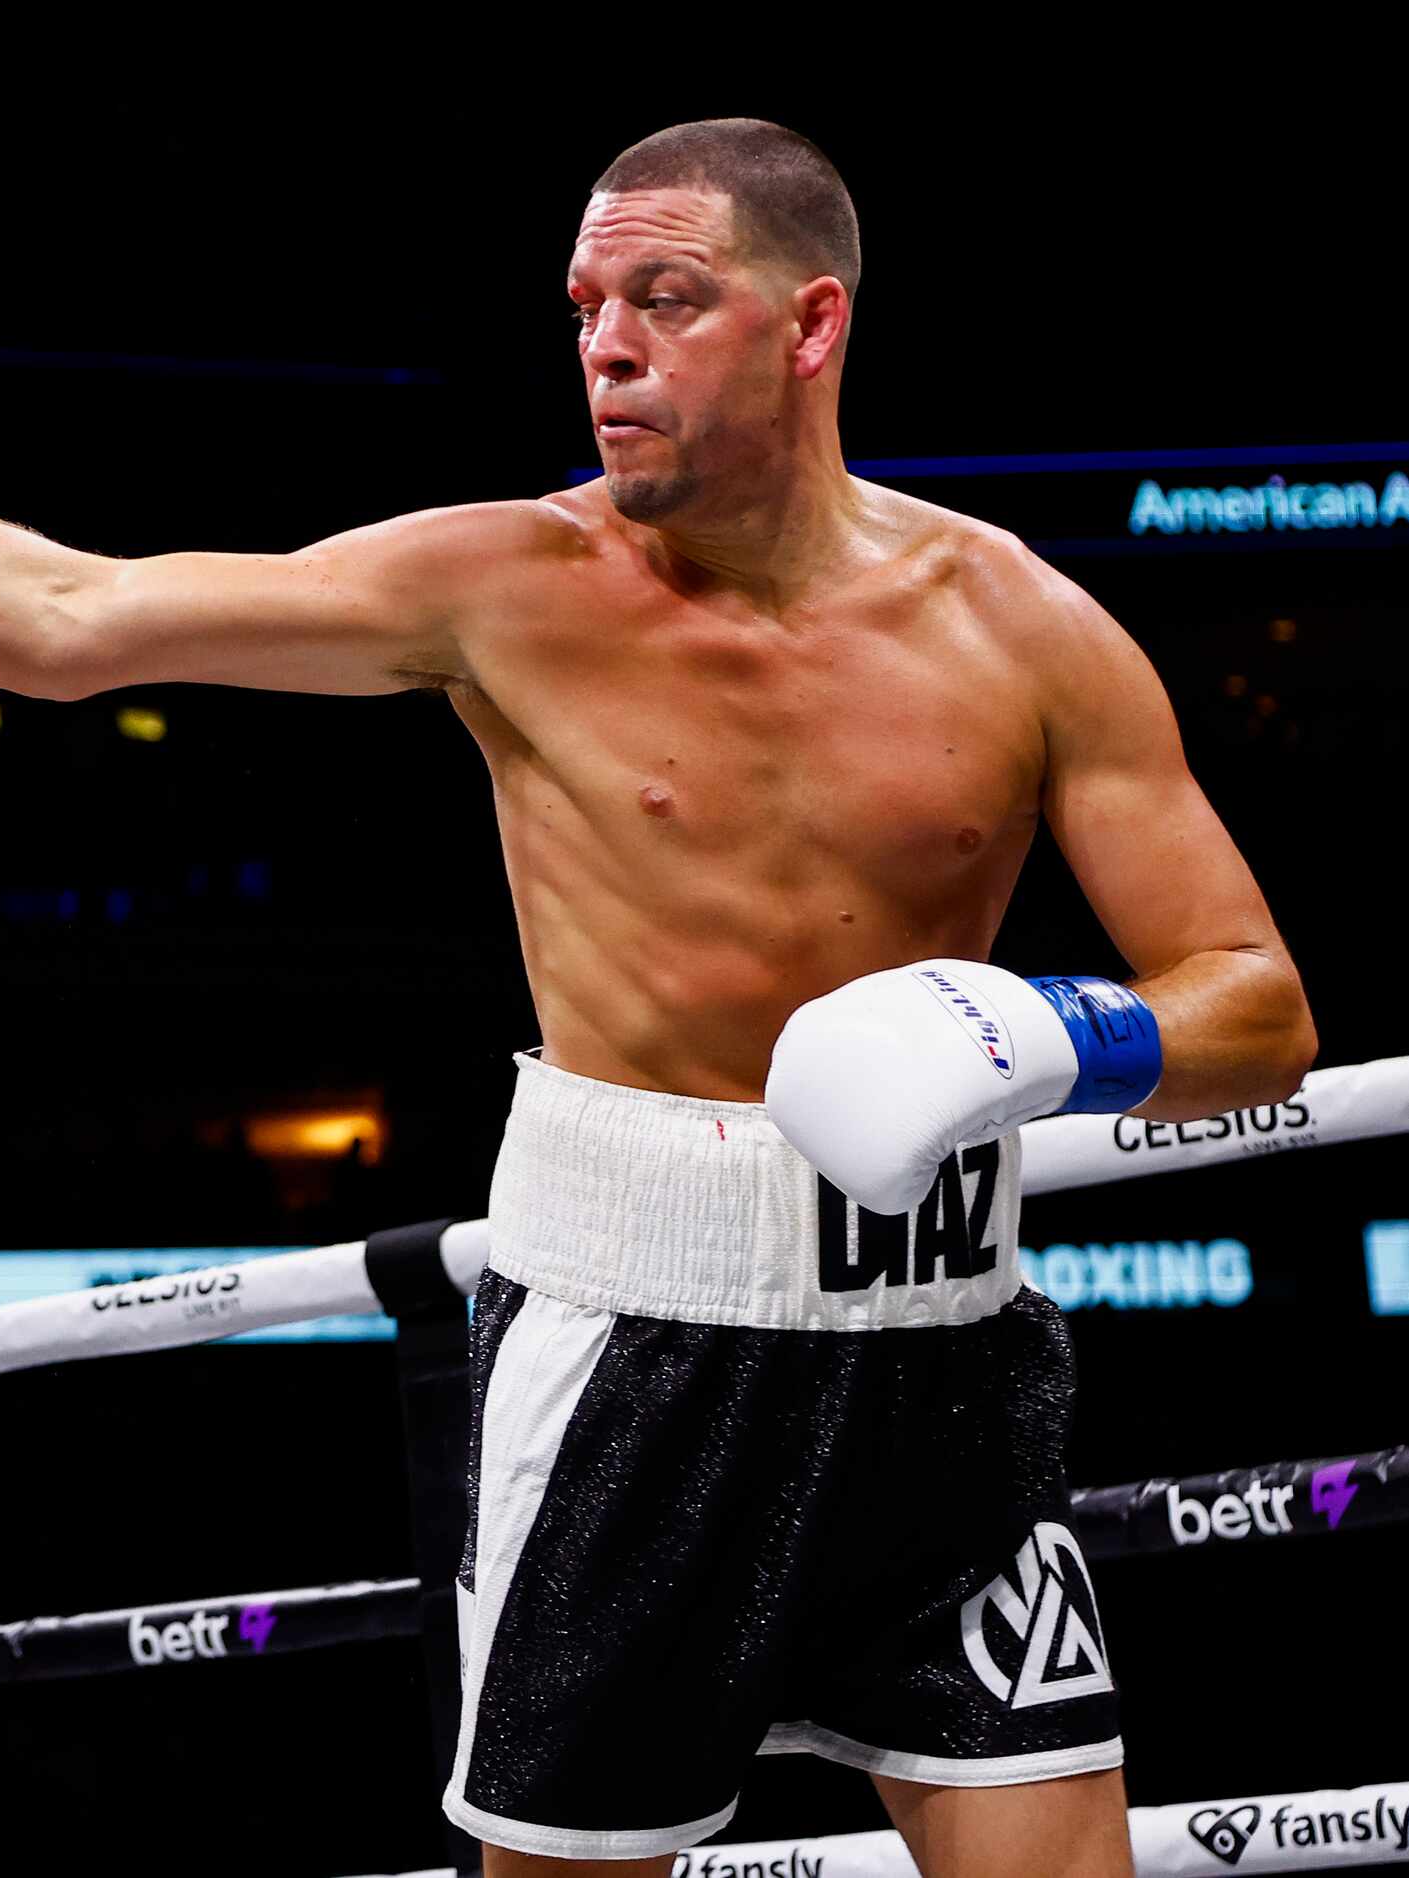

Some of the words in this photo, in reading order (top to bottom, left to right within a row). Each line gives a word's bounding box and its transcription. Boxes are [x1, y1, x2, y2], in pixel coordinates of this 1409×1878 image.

[1128, 476, 1377, 535] American
[1167, 1479, 1294, 1546] betr
[129, 1612, 229, 1666] betr
